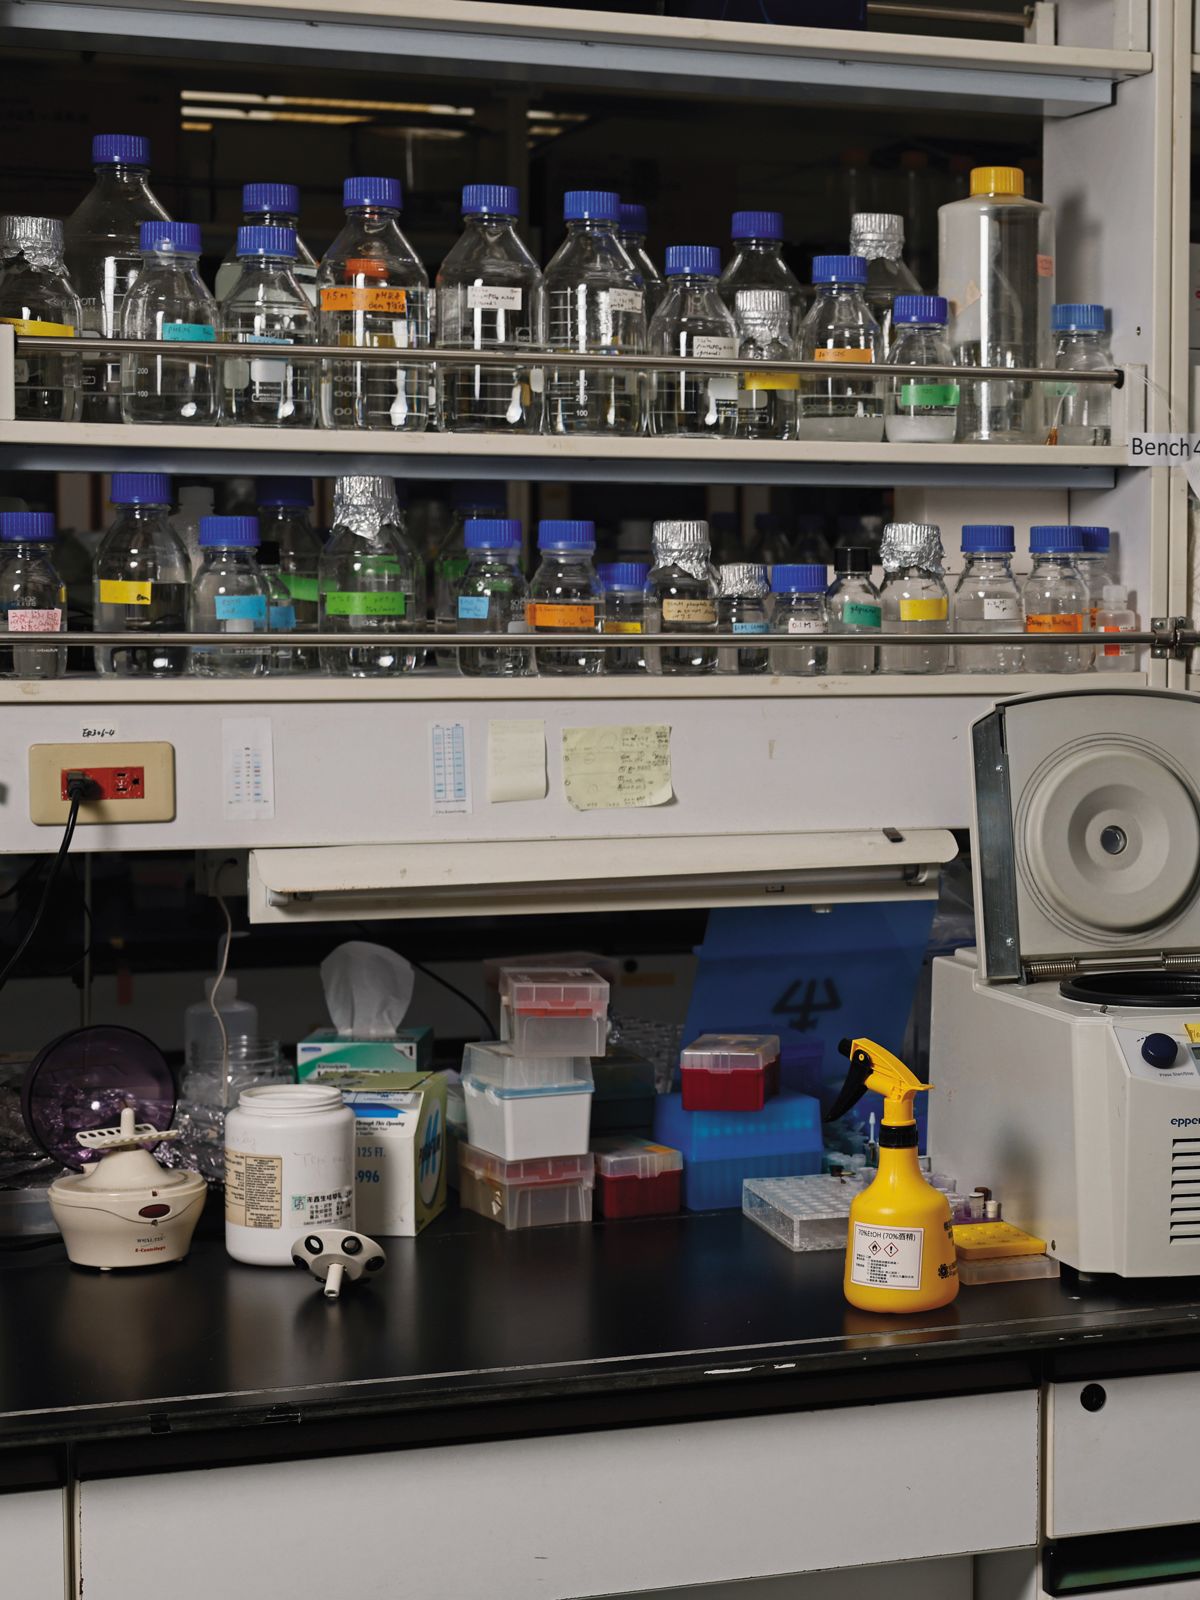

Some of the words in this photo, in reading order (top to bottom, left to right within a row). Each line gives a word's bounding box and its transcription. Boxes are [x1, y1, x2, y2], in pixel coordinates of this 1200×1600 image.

[137, 367, 148, 375] 200
[138, 390, 148, 398] 100
[1132, 438, 1190, 457] Bench
[357, 1147, 372, 1158] 125
[374, 1147, 386, 1158] FT.
